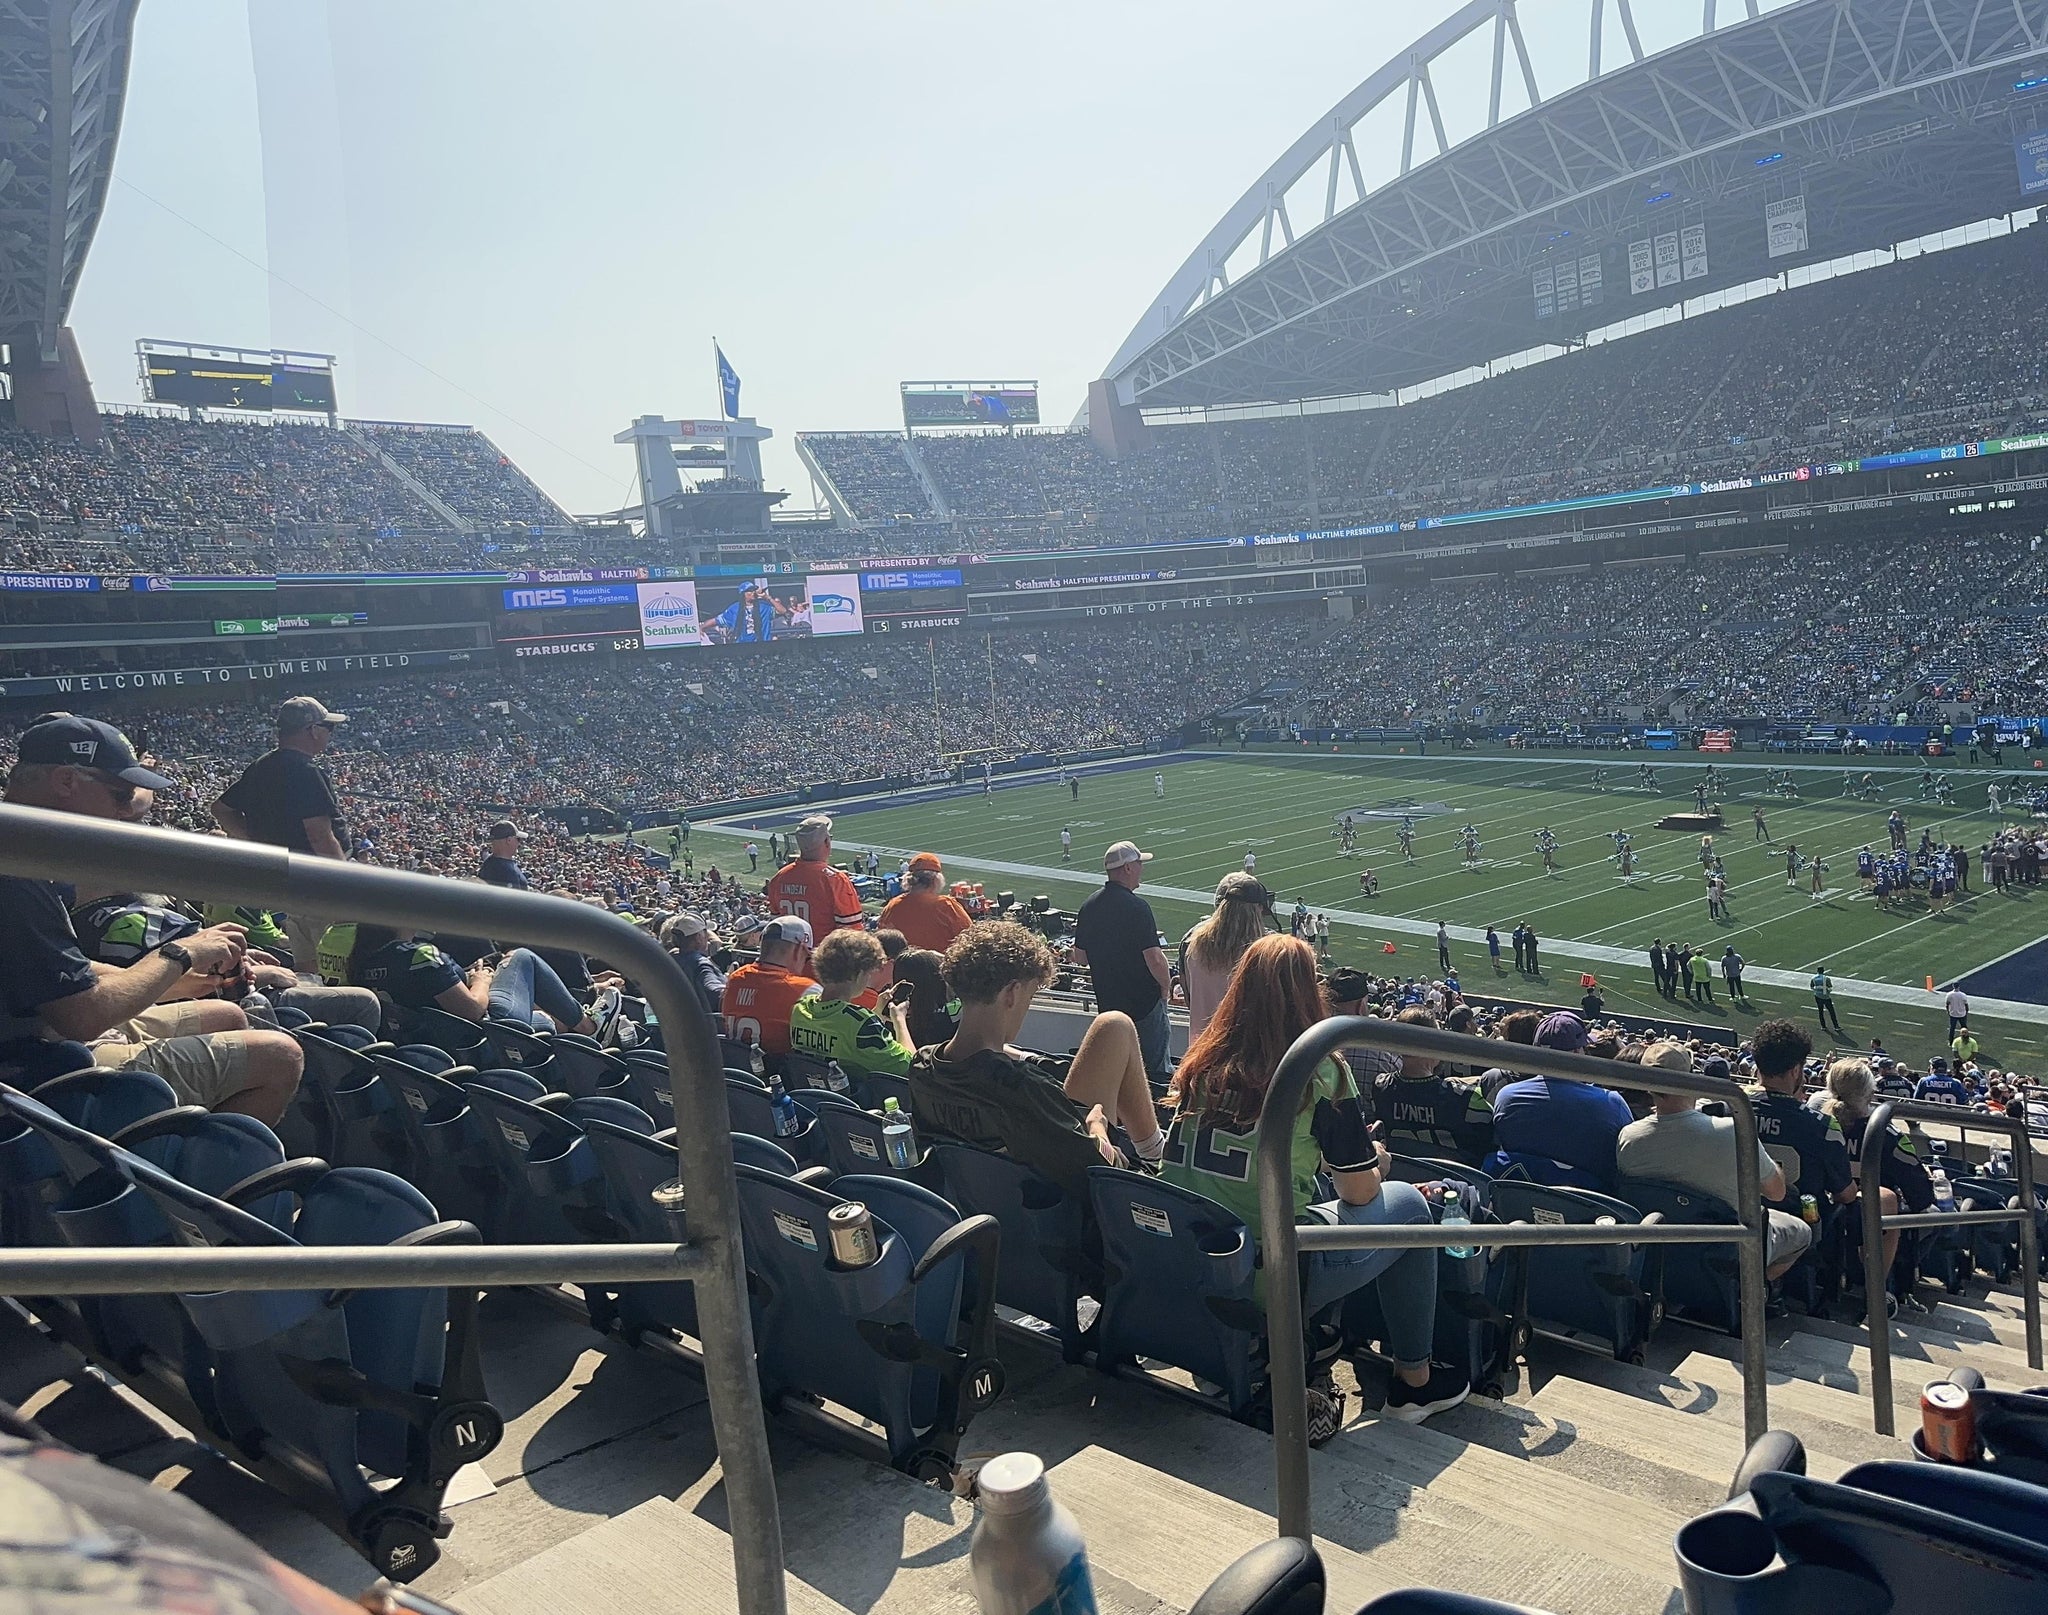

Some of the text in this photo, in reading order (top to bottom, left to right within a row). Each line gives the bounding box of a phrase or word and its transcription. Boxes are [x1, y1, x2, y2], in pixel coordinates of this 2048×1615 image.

[1685, 237, 1702, 248] 2014
[1658, 245, 1675, 255] 2013
[1632, 252, 1648, 262] 2005
[1941, 448, 1957, 459] 6:23
[1966, 444, 1976, 455] 25
[1815, 467, 1822, 476] 13
[1700, 477, 1752, 494] Seahawks
[2004, 483, 2025, 492] JACOB
[2027, 481, 2048, 490] GREEN
[1920, 493, 1934, 501] PAUL
[1942, 490, 1960, 499] ALLEN
[1254, 525, 1393, 546] Seahawks HALFTIME PRESENTED BY
[810, 562, 848, 571] Seahawks
[870, 559, 917, 567] PRESENTED
[539, 569, 593, 582] Seahawks
[8, 576, 73, 588] PRESENTED
[75, 577, 90, 589] BY
[1015, 578, 1061, 590] Seahawks
[1063, 576, 1098, 585] HALFTIME
[1100, 574, 1140, 583] PRESENTED
[573, 587, 611, 595] Monolithic
[513, 589, 567, 607] MPS
[574, 594, 629, 604] Power Systems
[1086, 604, 1134, 617] HOME
[1148, 602, 1167, 612] OF
[1180, 598, 1212, 609] THE
[901, 618, 960, 629] STARBUCKS
[645, 624, 697, 636] Seahawks
[516, 642, 595, 657] STARBUCKS
[614, 639, 638, 650] 6:23
[56, 655, 409, 692] WELCOME TO LUMEN FIELD
[76, 743, 89, 752] 12
[780, 884, 807, 895] LINDSAY
[736, 988, 757, 1006] NIX
[1393, 1102, 1435, 1124] LYNCH
[1518, 1329, 1524, 1344] K
[976, 1374, 991, 1398] M
[456, 1421, 476, 1446] N
